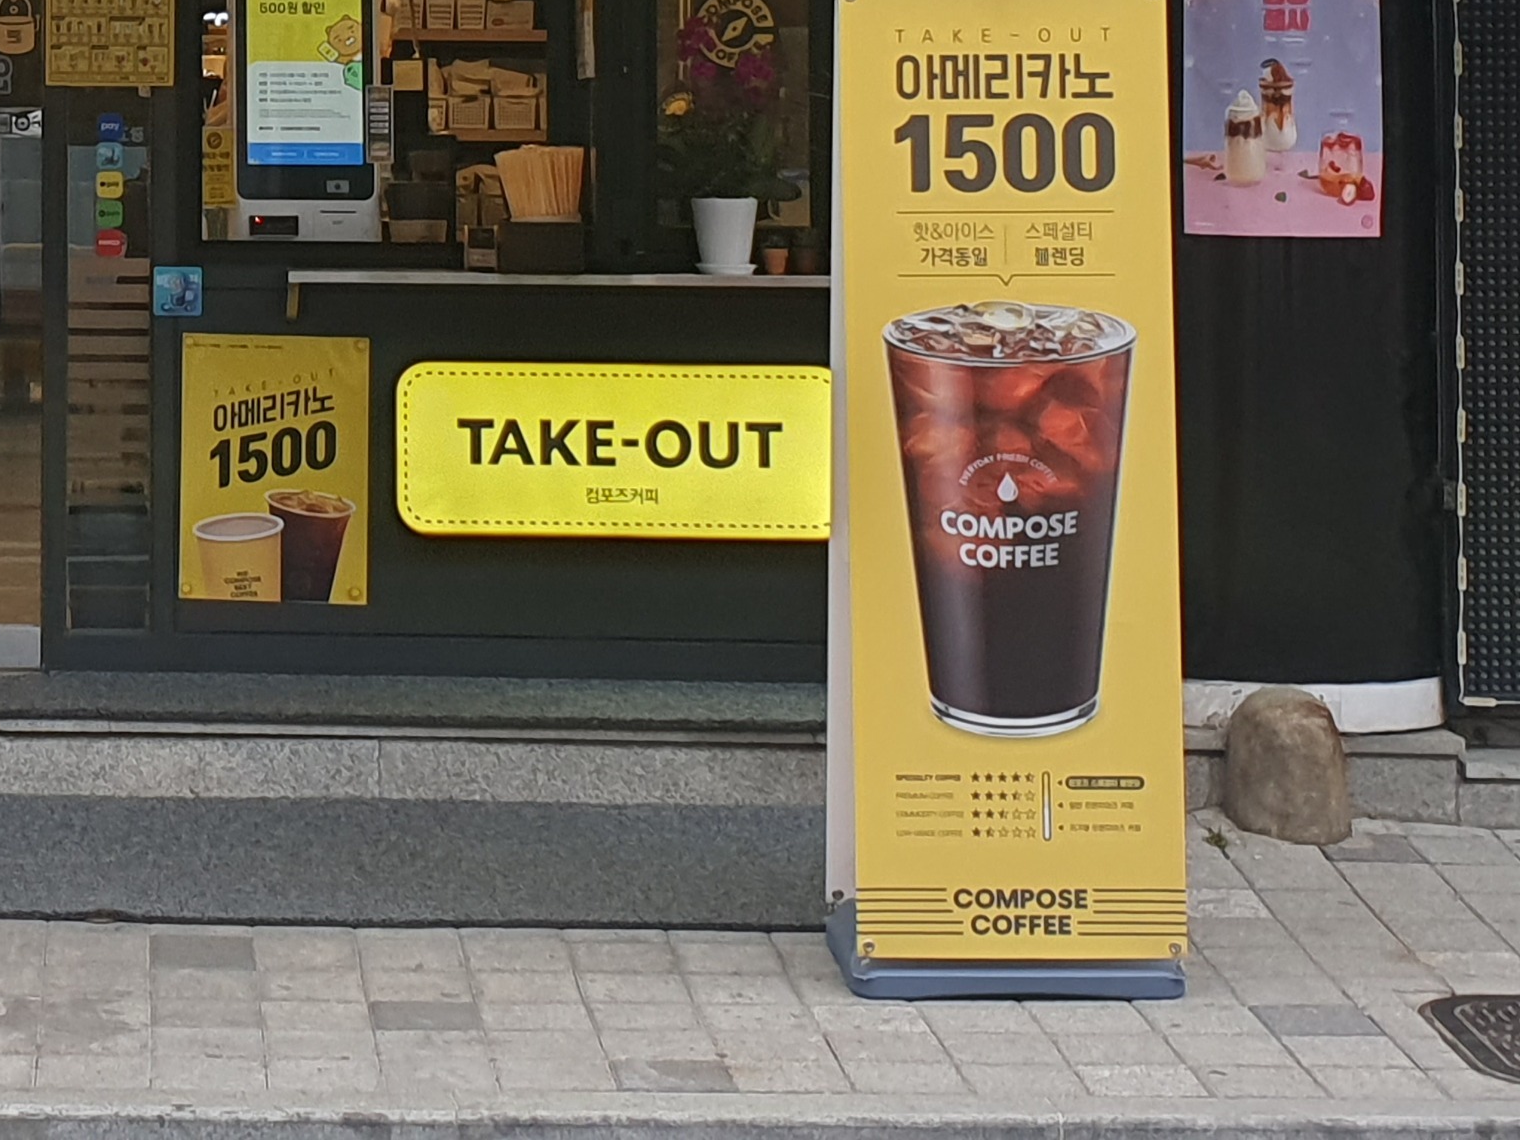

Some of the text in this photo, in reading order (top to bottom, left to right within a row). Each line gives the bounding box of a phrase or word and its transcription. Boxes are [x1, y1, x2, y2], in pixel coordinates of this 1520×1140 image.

[259, 1, 326, 15] 500원 할인
[894, 26, 1111, 44] TAKE-OUT
[895, 52, 1115, 101] 아메리카노
[893, 111, 1116, 193] 1500
[920, 246, 989, 268] 가격동일
[1034, 246, 1086, 268] 블렌딩
[213, 385, 336, 433] 아메리카노
[209, 420, 337, 489] 1500
[456, 418, 784, 470] TAKE-OUT
[585, 486, 660, 506] 컴포즈커피
[939, 509, 1079, 541] COMPOSE
[958, 542, 1060, 570] COFFEE
[952, 887, 1089, 910] COMPOSE
[970, 914, 1073, 936] COFFEE
